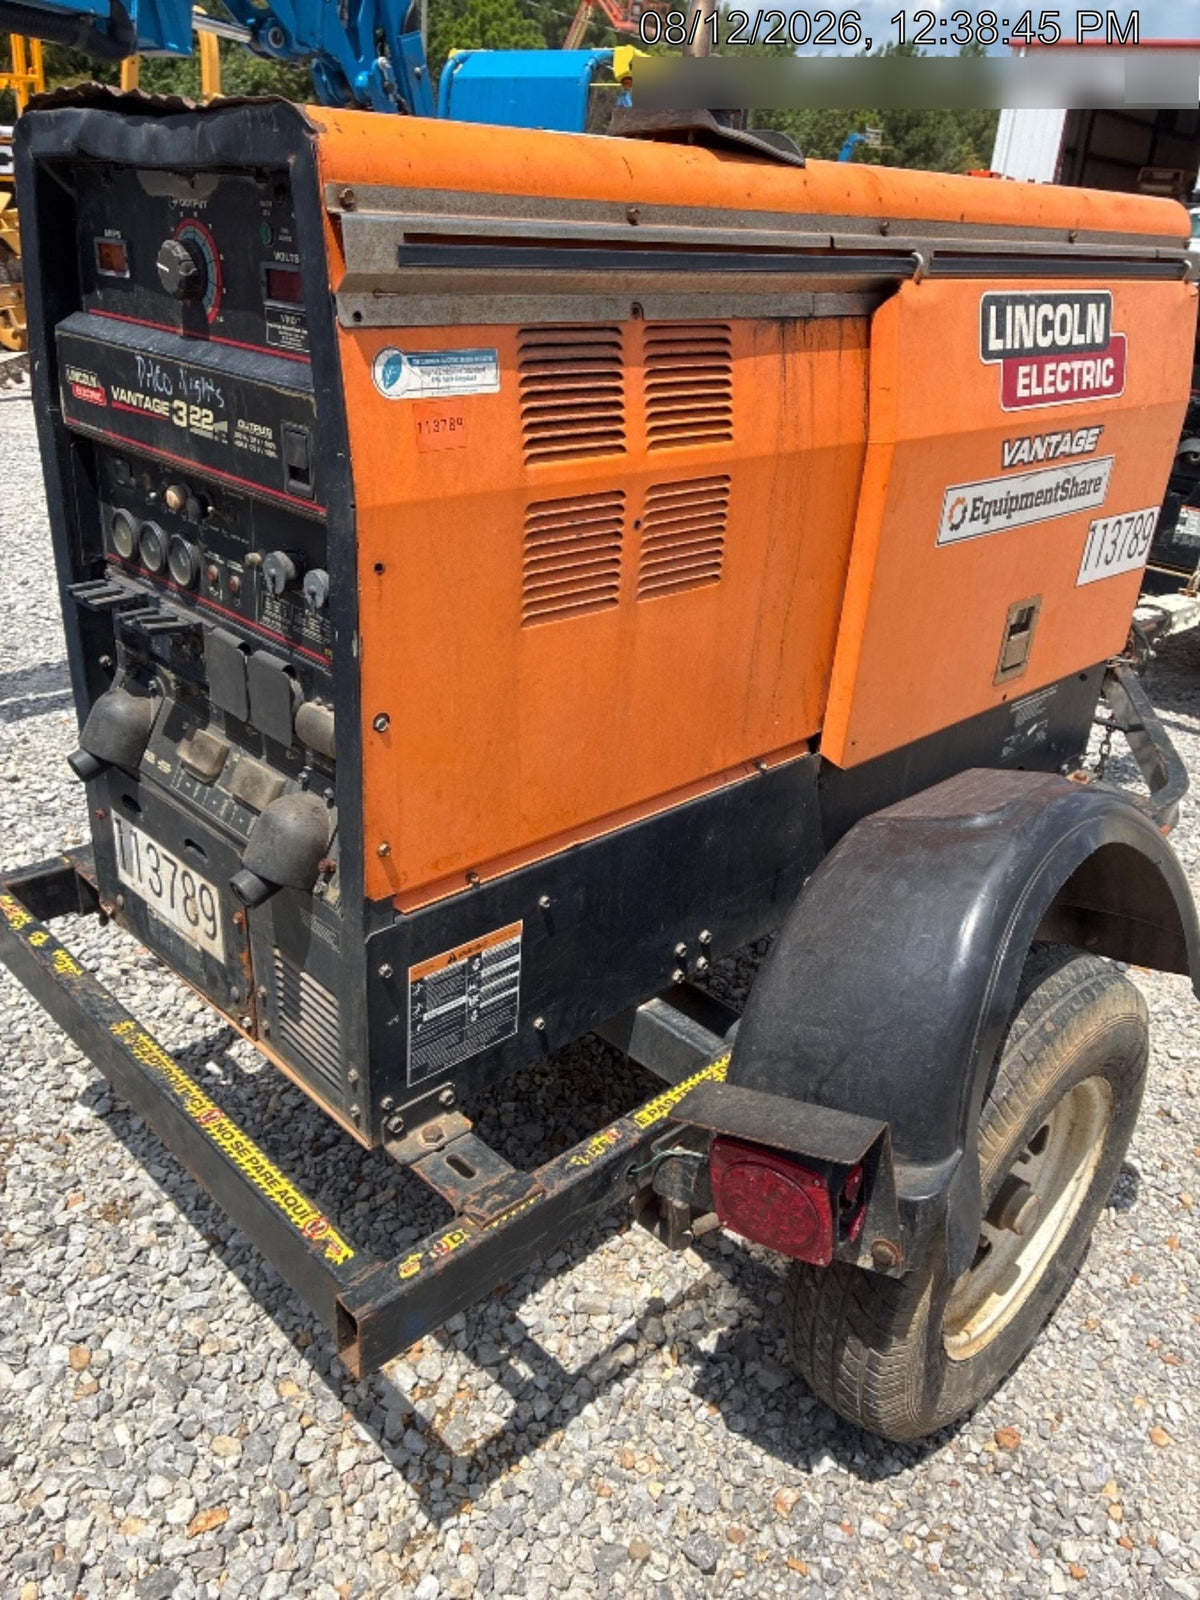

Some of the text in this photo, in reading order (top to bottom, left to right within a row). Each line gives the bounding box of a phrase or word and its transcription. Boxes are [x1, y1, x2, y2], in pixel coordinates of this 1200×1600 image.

[273, 251, 300, 263] VOLTS
[988, 303, 1106, 351] LINCOLN
[1016, 357, 1115, 398] ELECTRIC
[110, 385, 215, 431] VANTAGE 322
[417, 417, 464, 434] 113789
[1002, 426, 1103, 468] VANTAGE
[968, 475, 1105, 525] EquipmentShare
[1083, 511, 1156, 570] 113789
[114, 817, 217, 941] 113789
[213, 1122, 235, 1141] NO
[230, 1139, 252, 1158] SE
[247, 1156, 281, 1190] PARE
